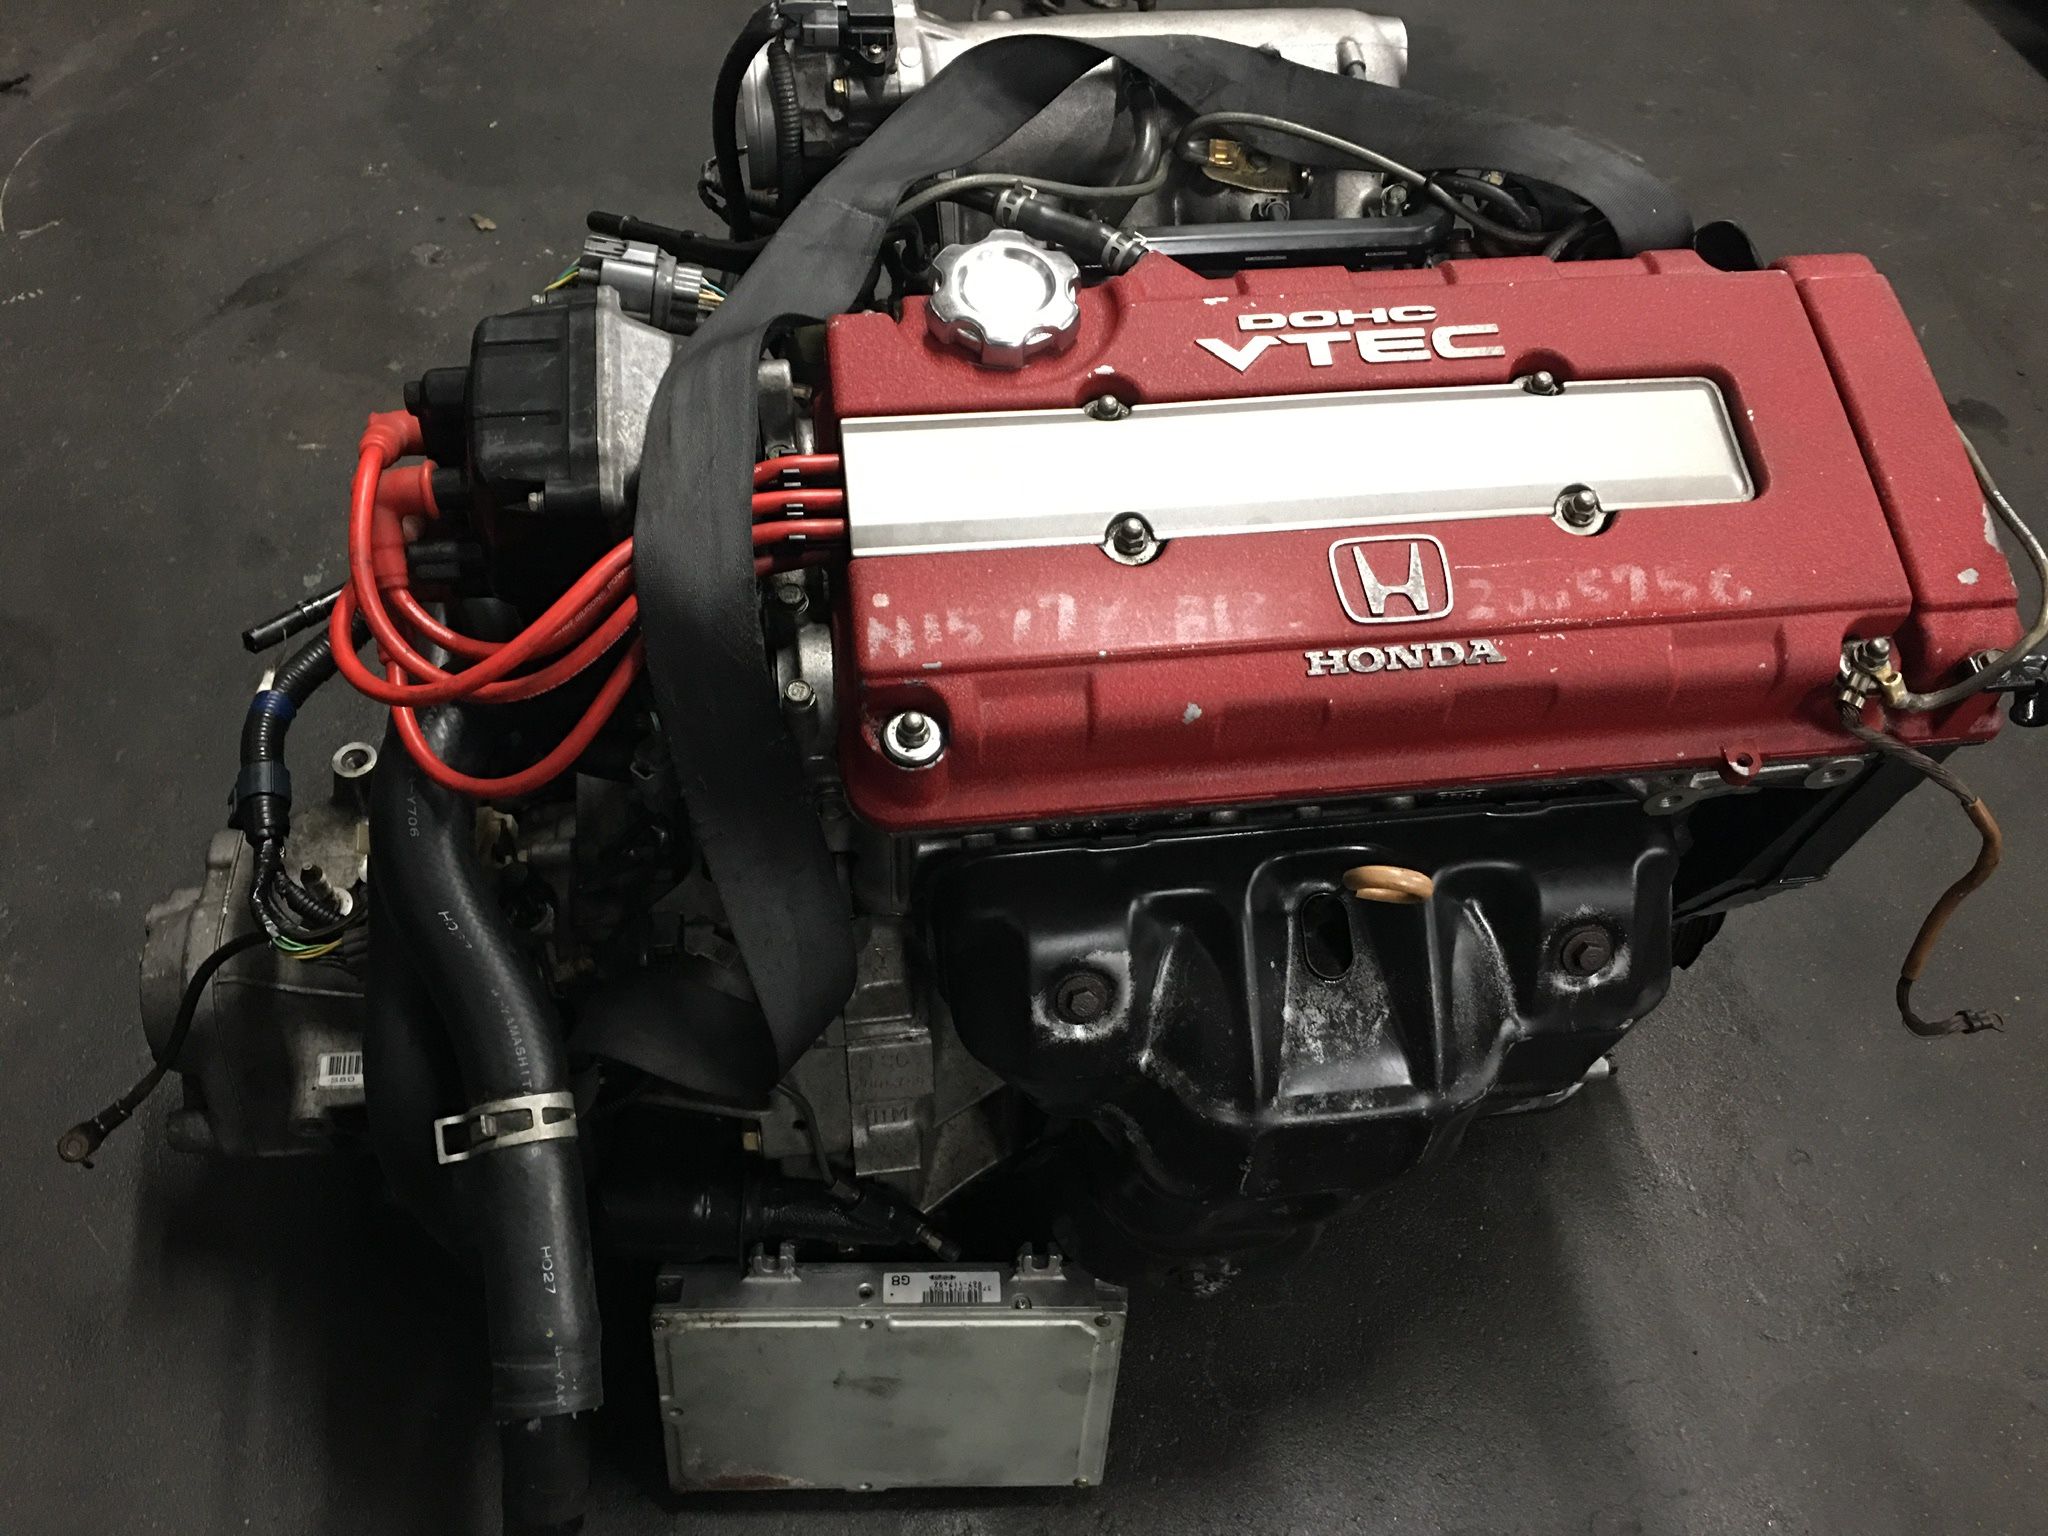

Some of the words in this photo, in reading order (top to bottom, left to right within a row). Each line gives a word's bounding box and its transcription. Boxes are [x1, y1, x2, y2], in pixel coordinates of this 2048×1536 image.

[1238, 305, 1437, 330] DOHC
[1194, 323, 1505, 372] VTEC
[1304, 639, 1506, 676] HONDA
[891, 1275, 911, 1286] G8
